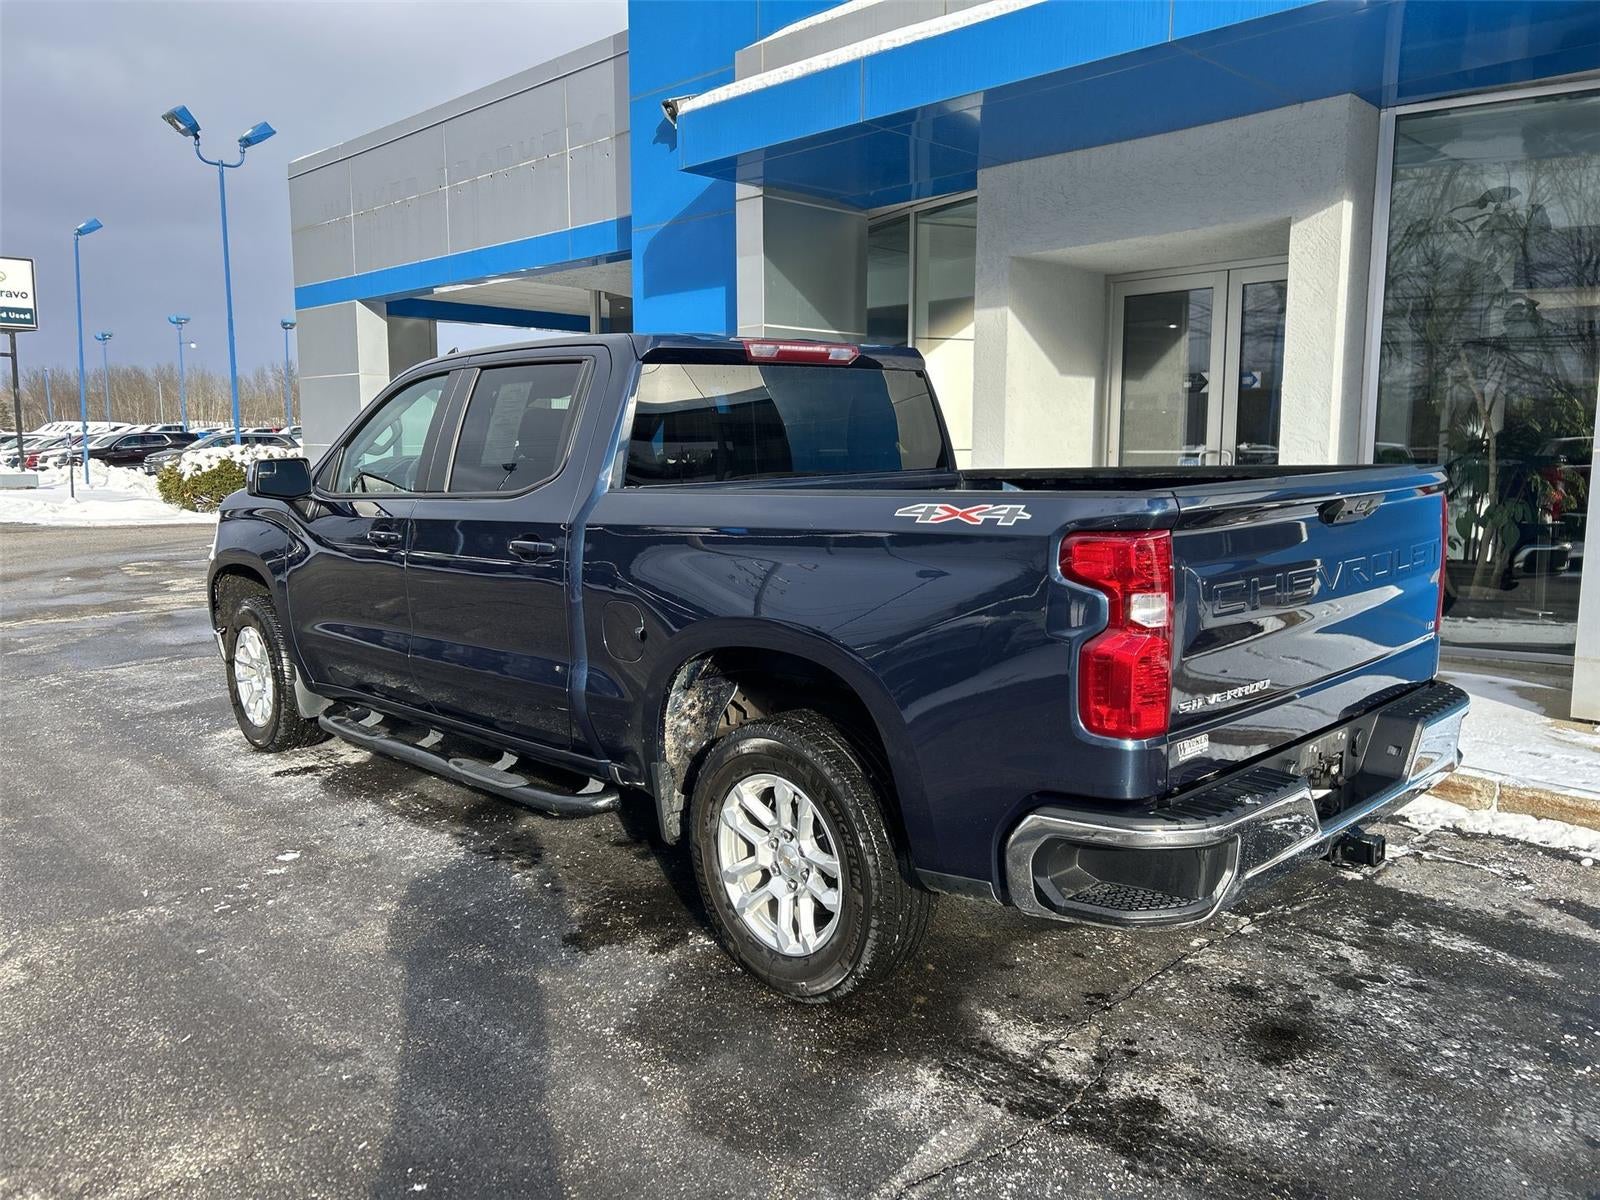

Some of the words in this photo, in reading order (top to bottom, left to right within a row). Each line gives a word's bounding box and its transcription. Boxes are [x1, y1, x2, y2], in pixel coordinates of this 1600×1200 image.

[8, 311, 31, 319] Used
[1212, 538, 1439, 618] CHEVROLET
[1178, 679, 1271, 713] SILVERADO
[829, 800, 862, 890] MICHELIN
